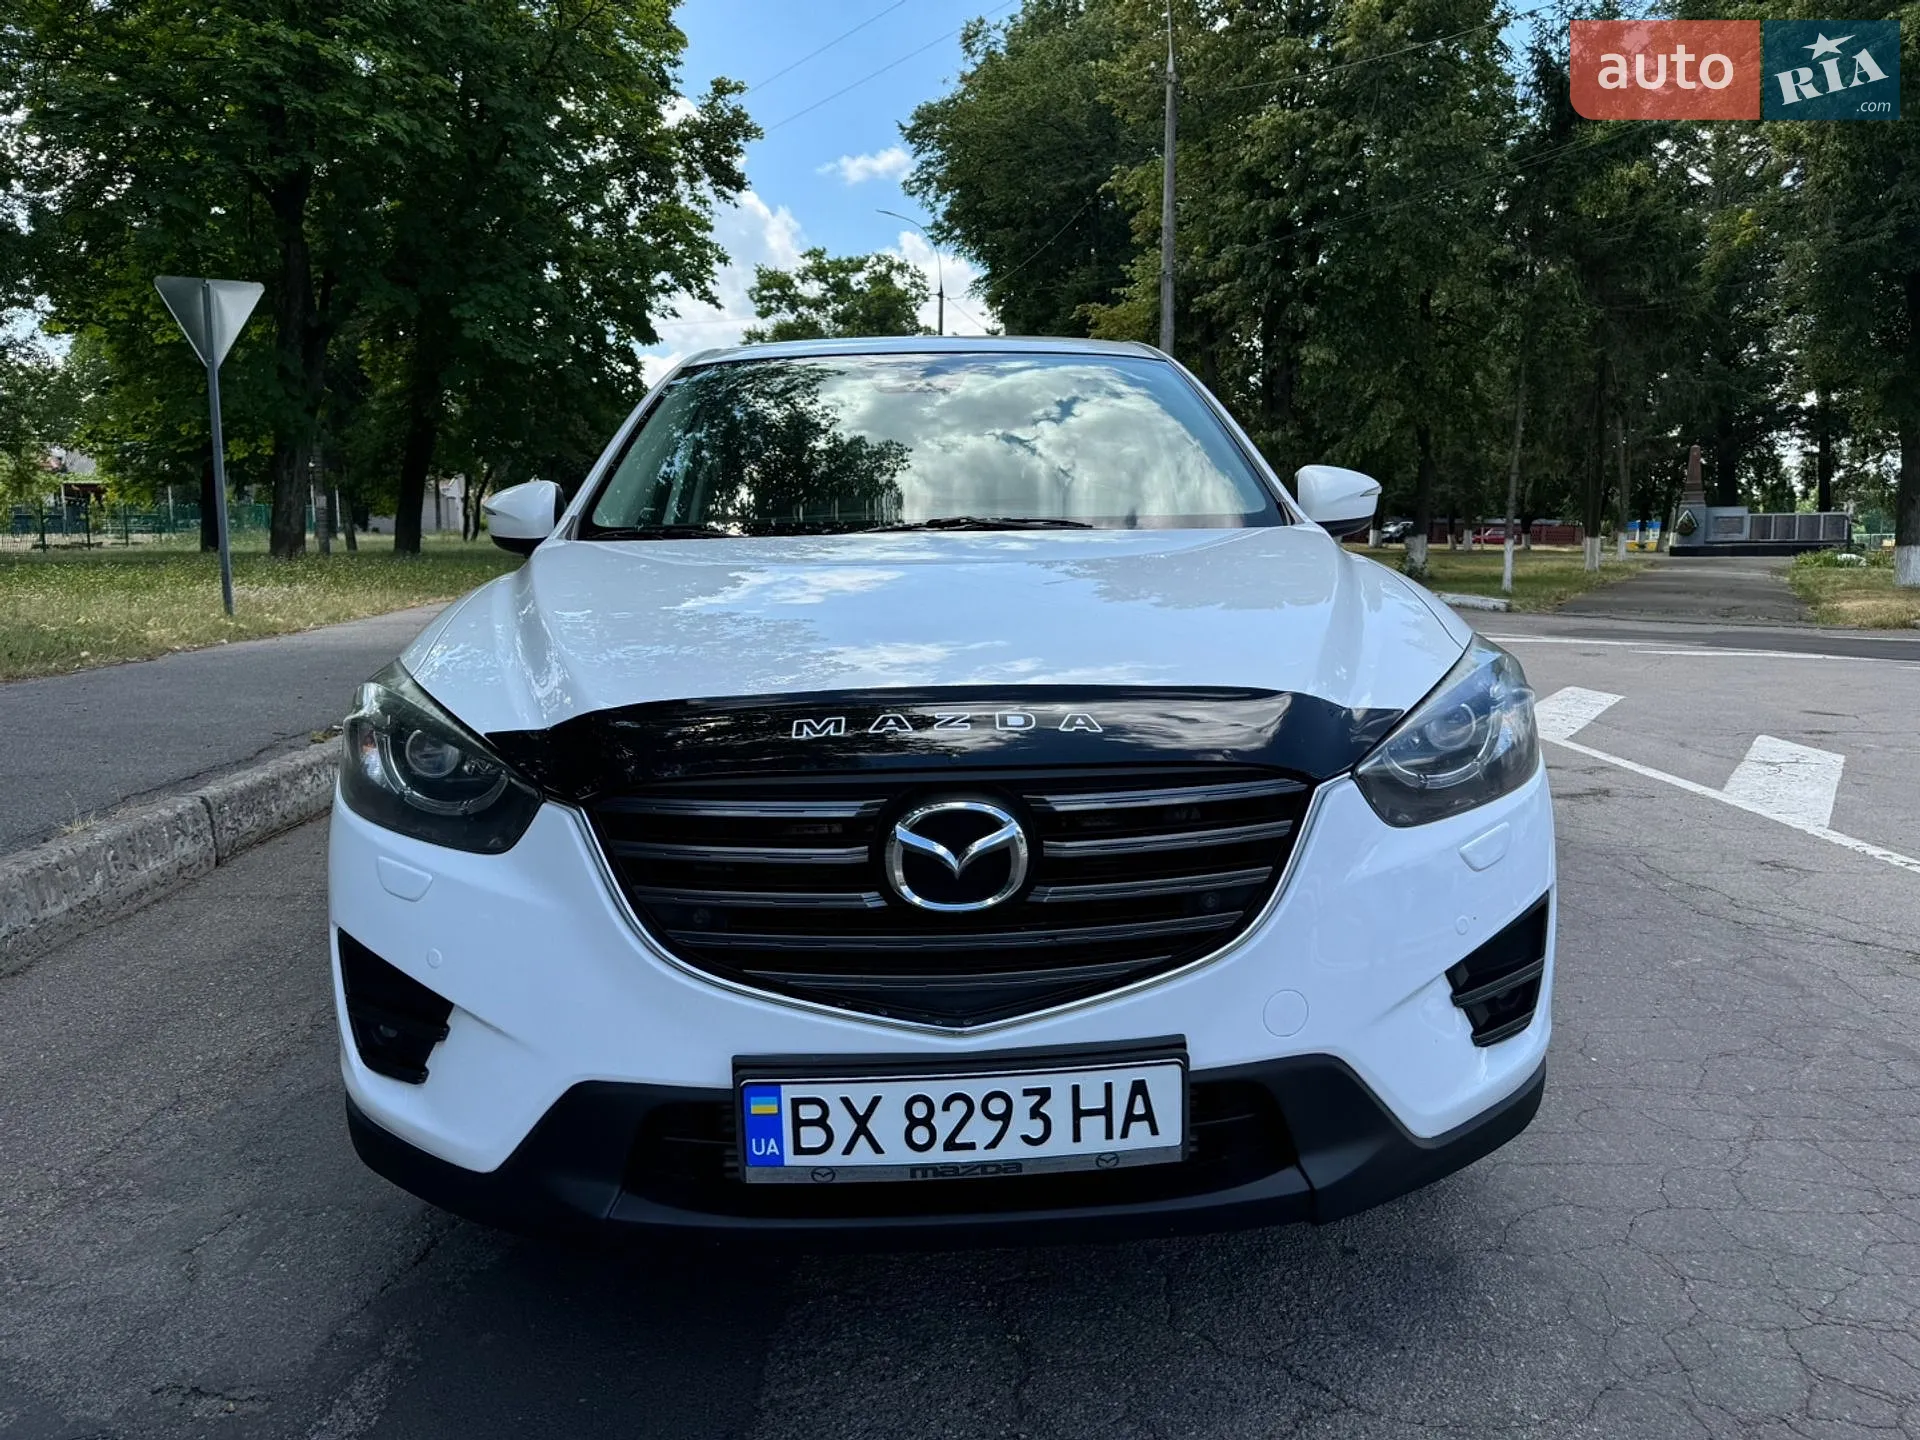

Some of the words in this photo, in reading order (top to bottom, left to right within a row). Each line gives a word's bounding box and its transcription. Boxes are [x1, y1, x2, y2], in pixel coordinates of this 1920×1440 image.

[791, 713, 1103, 738] MAZDA
[790, 1095, 885, 1157] BX
[903, 1086, 1052, 1152] 8293
[1071, 1078, 1159, 1143] HA
[751, 1138, 780, 1156] UA
